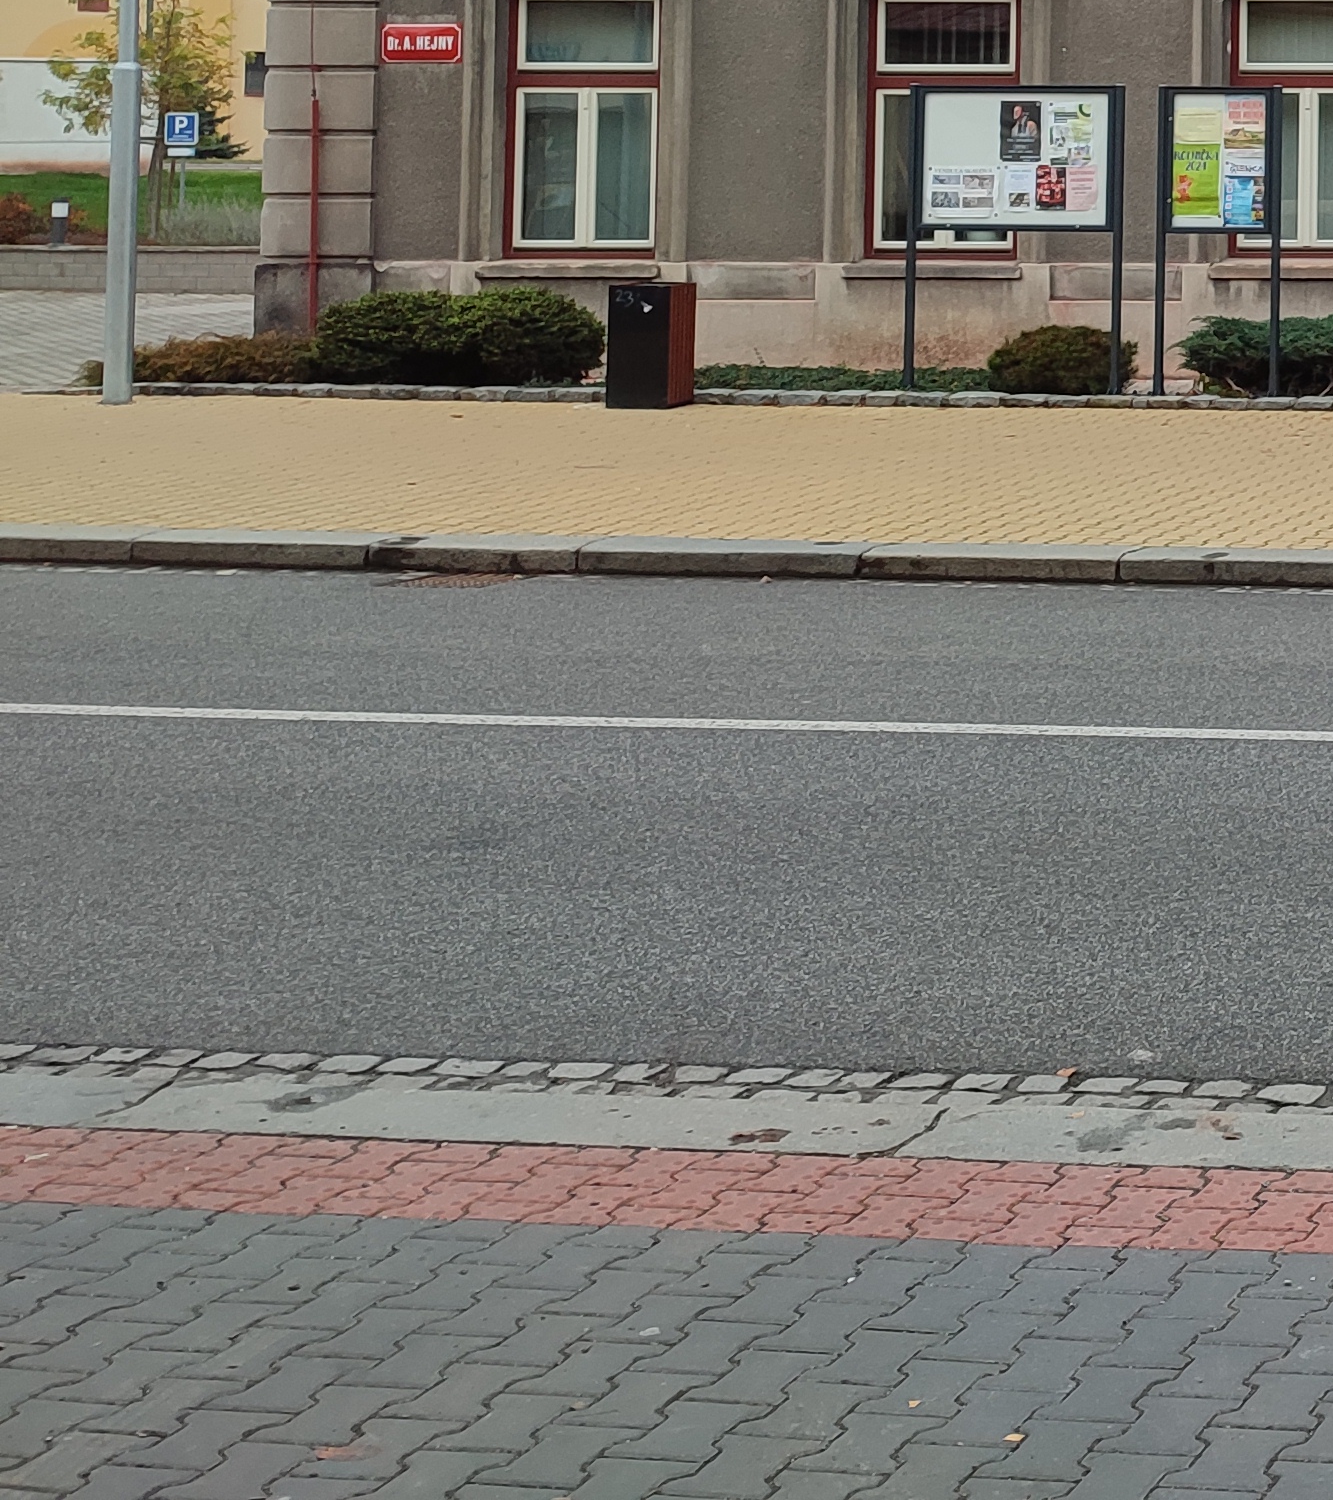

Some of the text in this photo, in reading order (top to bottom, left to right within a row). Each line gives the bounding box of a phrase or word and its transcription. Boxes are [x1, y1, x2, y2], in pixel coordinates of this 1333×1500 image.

[387, 35, 454, 50] Dr. A. HEJNY
[175, 117, 188, 134] P
